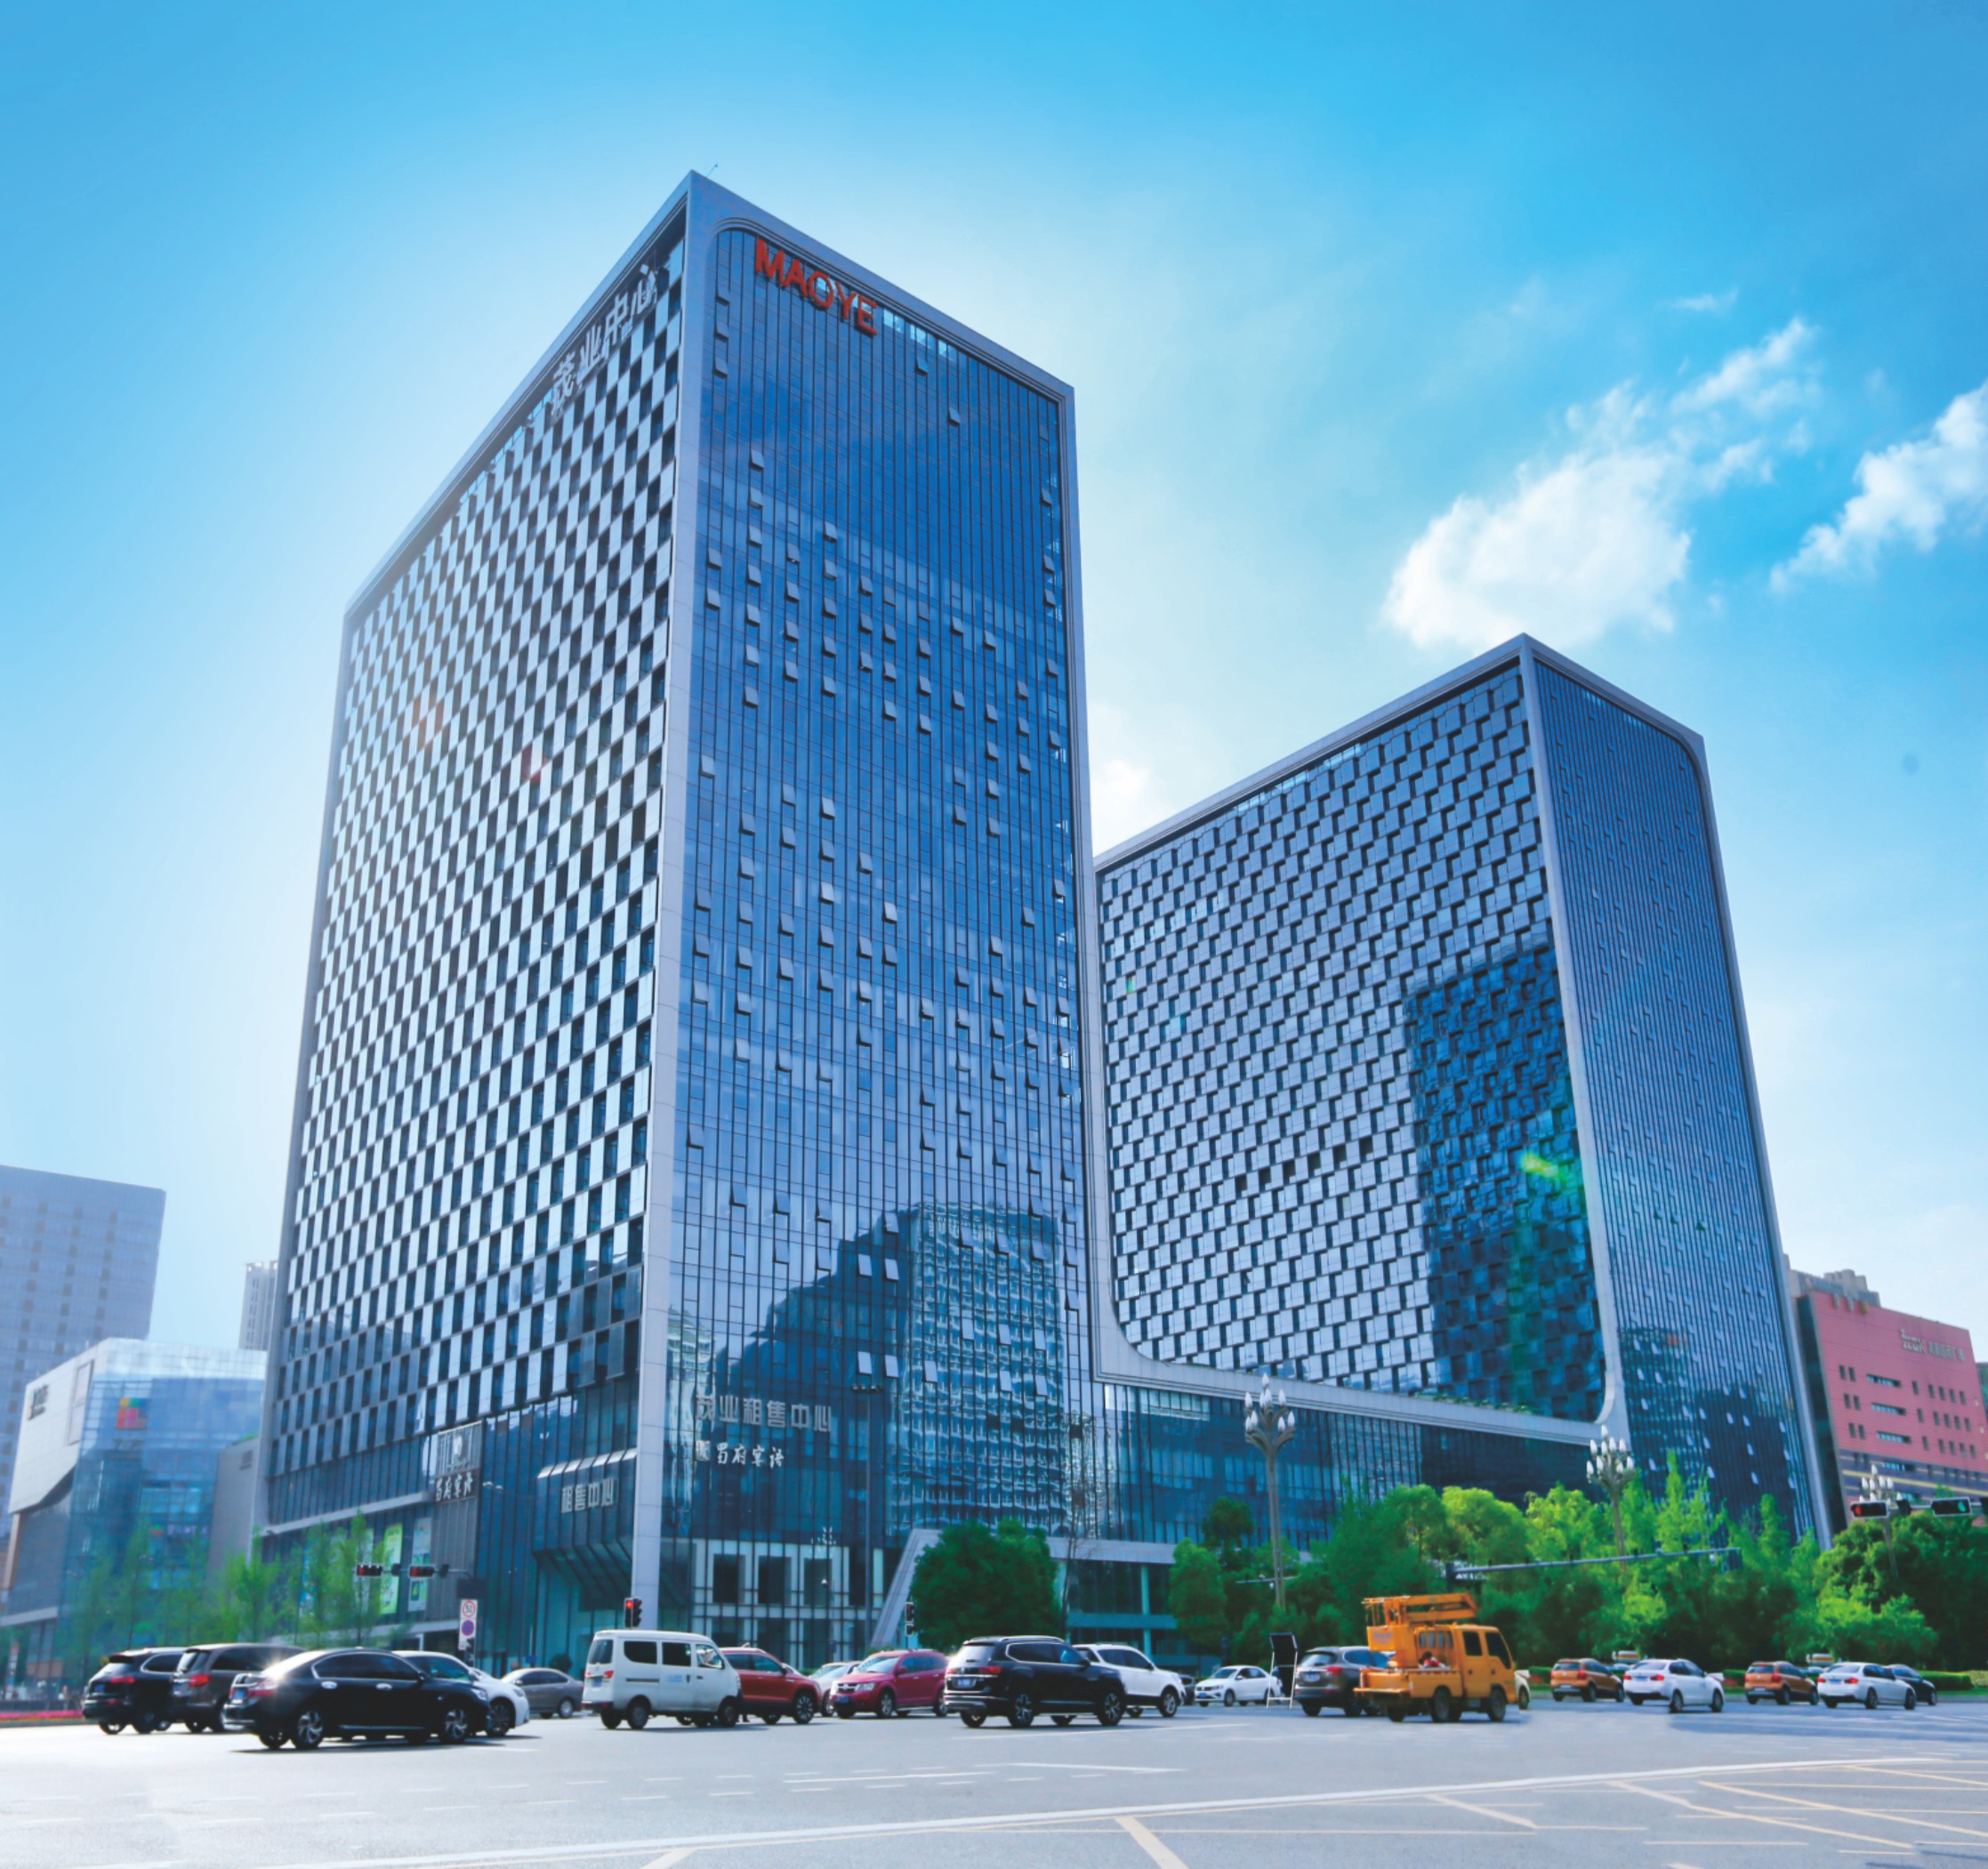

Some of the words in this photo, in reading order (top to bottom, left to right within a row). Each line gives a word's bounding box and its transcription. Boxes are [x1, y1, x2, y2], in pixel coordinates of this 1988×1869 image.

[755, 238, 878, 335] MAOYE
[695, 1394, 832, 1432] 茂业租售中心
[560, 1477, 615, 1513] 租售中心
